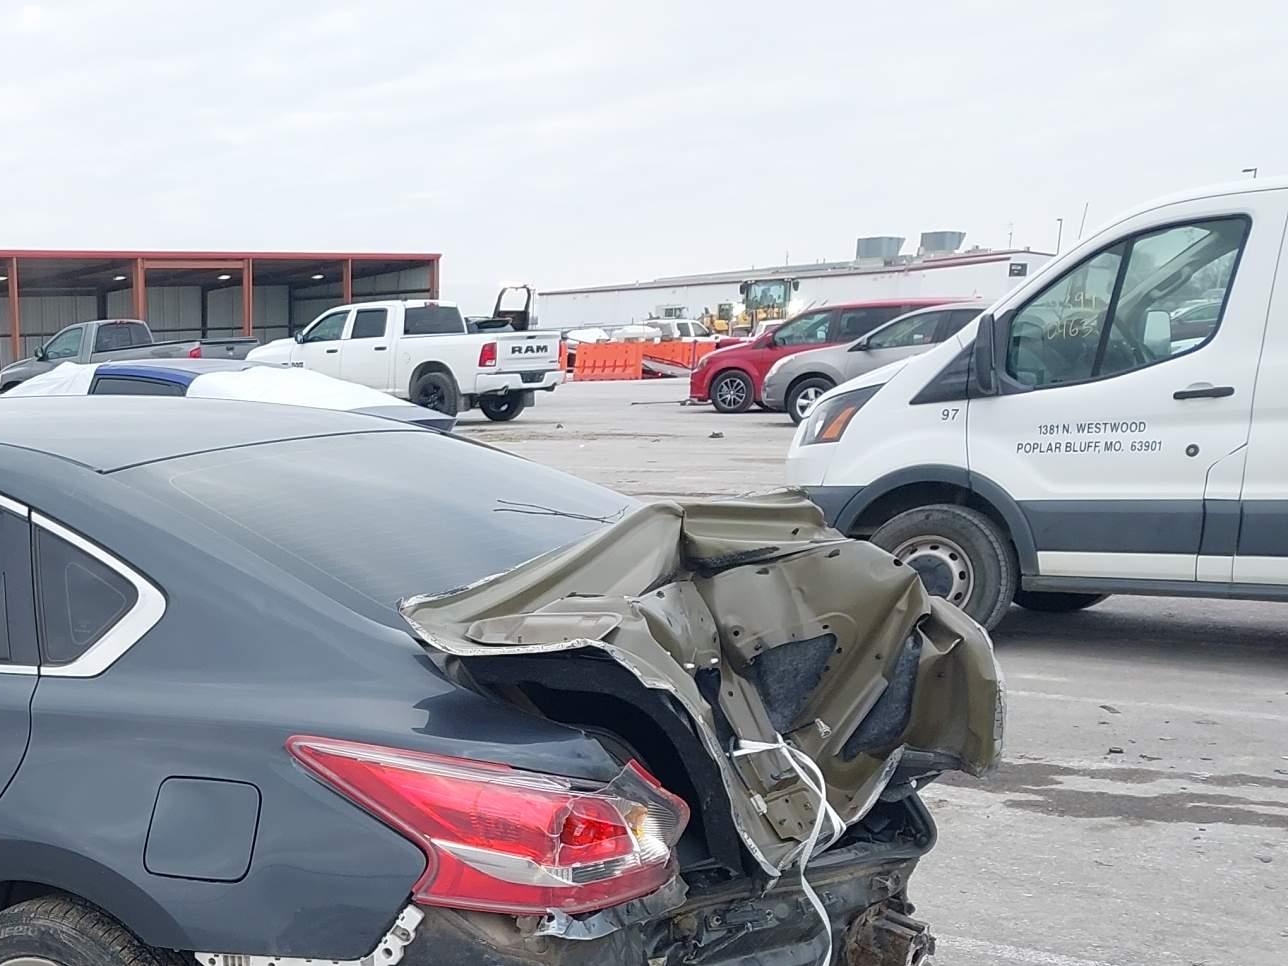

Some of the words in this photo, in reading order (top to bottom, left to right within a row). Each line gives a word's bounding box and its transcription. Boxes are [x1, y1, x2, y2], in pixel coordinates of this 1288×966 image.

[511, 345, 549, 354] RAM
[941, 408, 960, 421] 97
[1038, 424, 1060, 435] 1381
[1062, 423, 1073, 435] N.
[1076, 421, 1147, 434] WESTWOOD
[1016, 442, 1062, 454] POPLAR
[1064, 441, 1101, 454] BLUFF,
[1103, 441, 1124, 452] MO.
[1130, 440, 1163, 452] 63901
